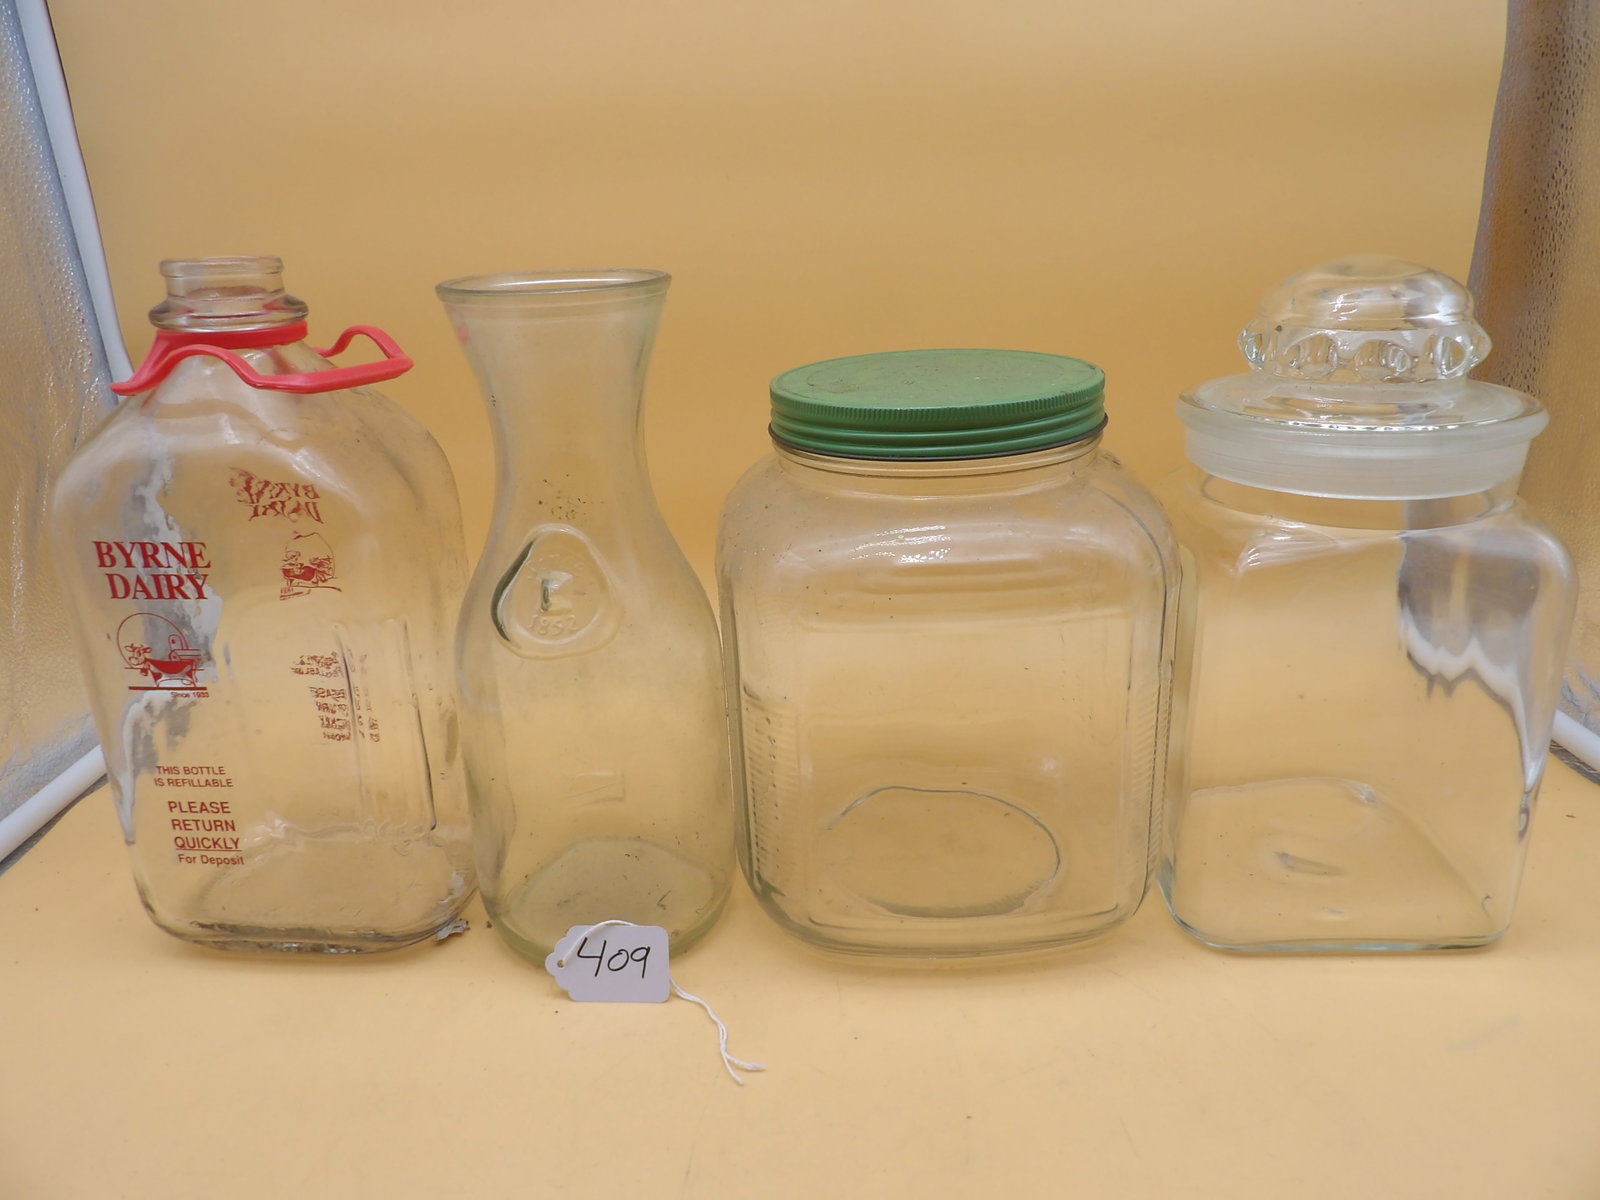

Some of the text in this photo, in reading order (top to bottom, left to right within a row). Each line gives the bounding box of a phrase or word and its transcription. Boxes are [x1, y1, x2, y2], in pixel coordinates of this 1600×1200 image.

[91, 540, 211, 569] BYRNE
[105, 573, 209, 600] DAIRY
[155, 765, 226, 775] THIS BOTTLE
[154, 778, 234, 787] IS REFILLABLE
[167, 800, 231, 814] PLEASE
[171, 819, 236, 832] RETURN
[174, 836, 240, 850] QUICKLY
[177, 853, 245, 867] For Deposit
[577, 937, 651, 979] 409
